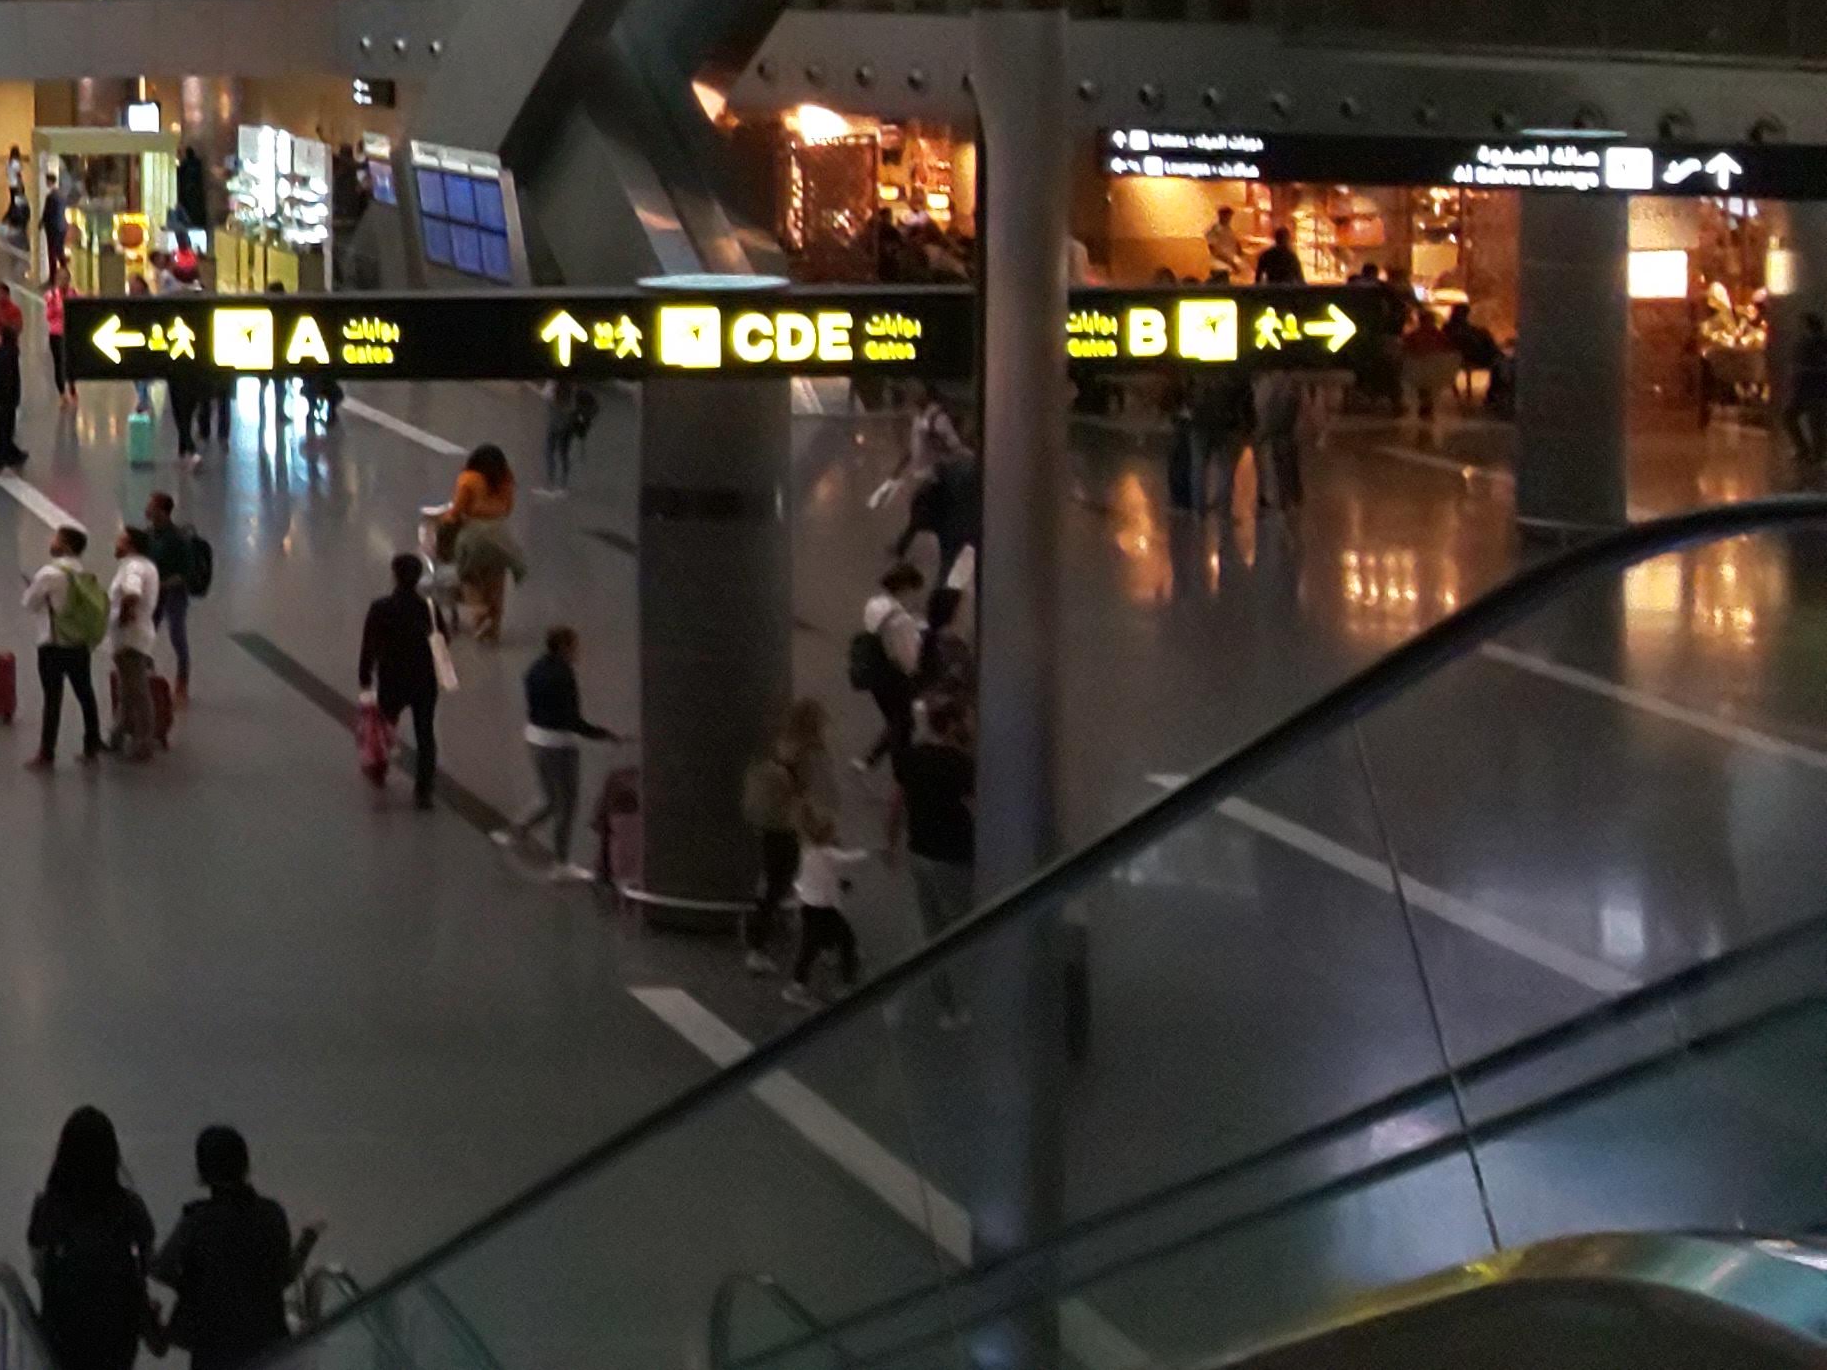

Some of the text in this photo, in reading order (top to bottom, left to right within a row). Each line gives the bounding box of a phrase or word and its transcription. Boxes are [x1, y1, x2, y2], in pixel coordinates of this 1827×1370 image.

[286, 316, 329, 363] A
[730, 312, 853, 362] CDE
[1126, 308, 1167, 356] B
